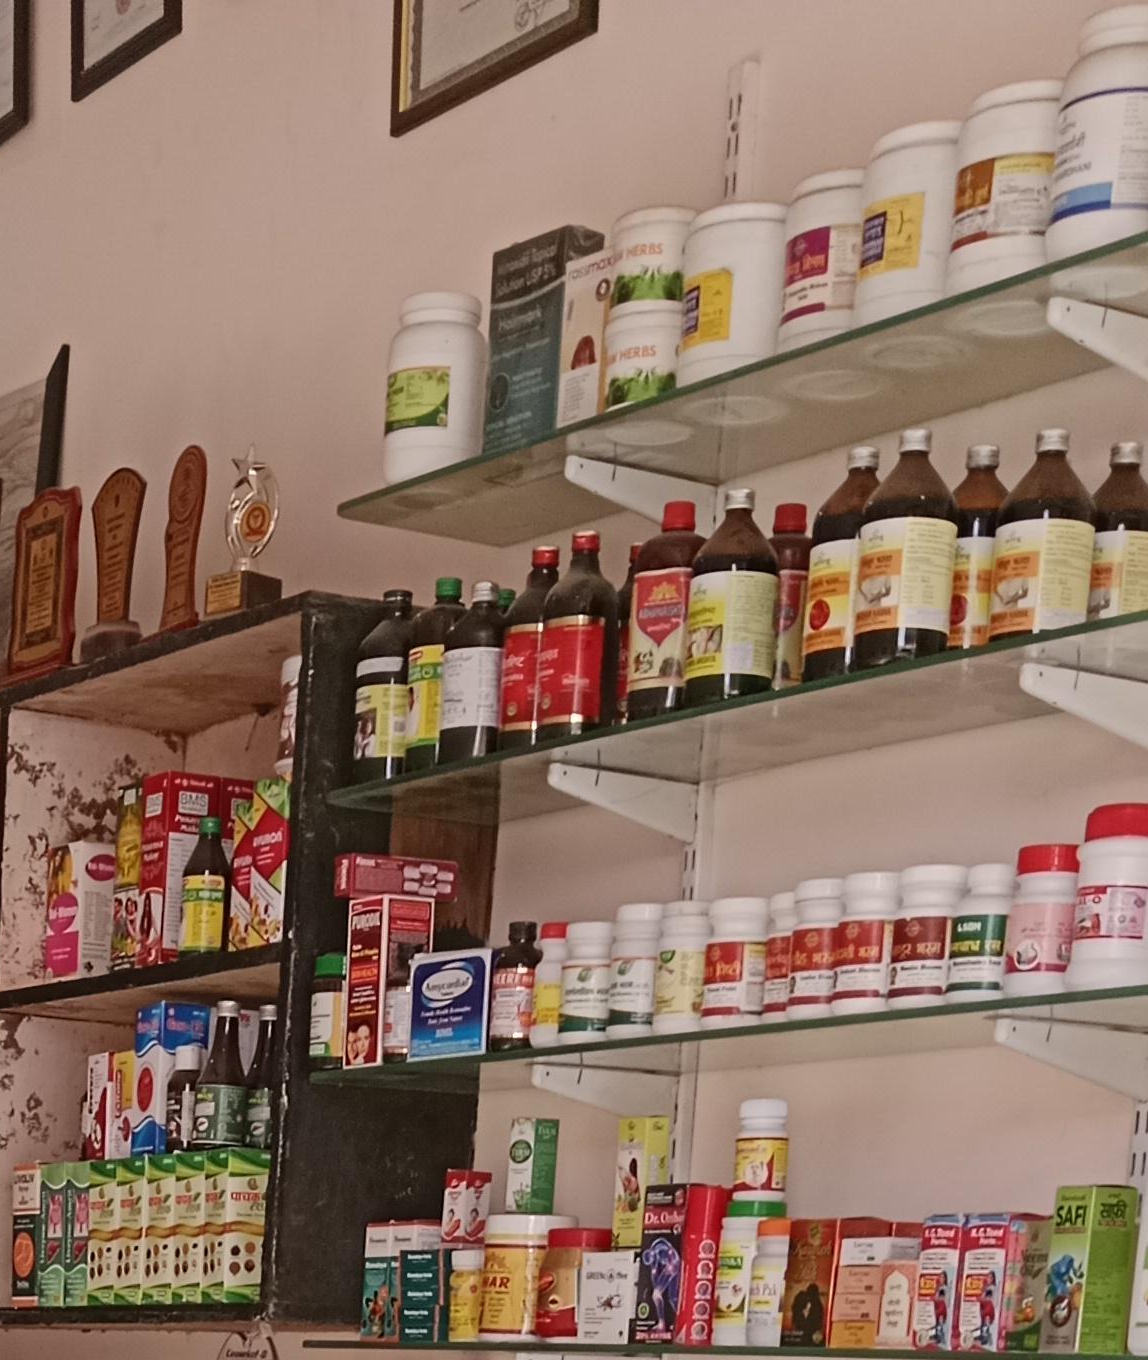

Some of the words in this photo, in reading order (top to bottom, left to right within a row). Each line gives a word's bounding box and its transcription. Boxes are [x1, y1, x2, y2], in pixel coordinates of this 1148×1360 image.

[626, 243, 663, 258] HERBS
[619, 345, 657, 362] HERBS
[1055, 1204, 1088, 1227] SAFI
